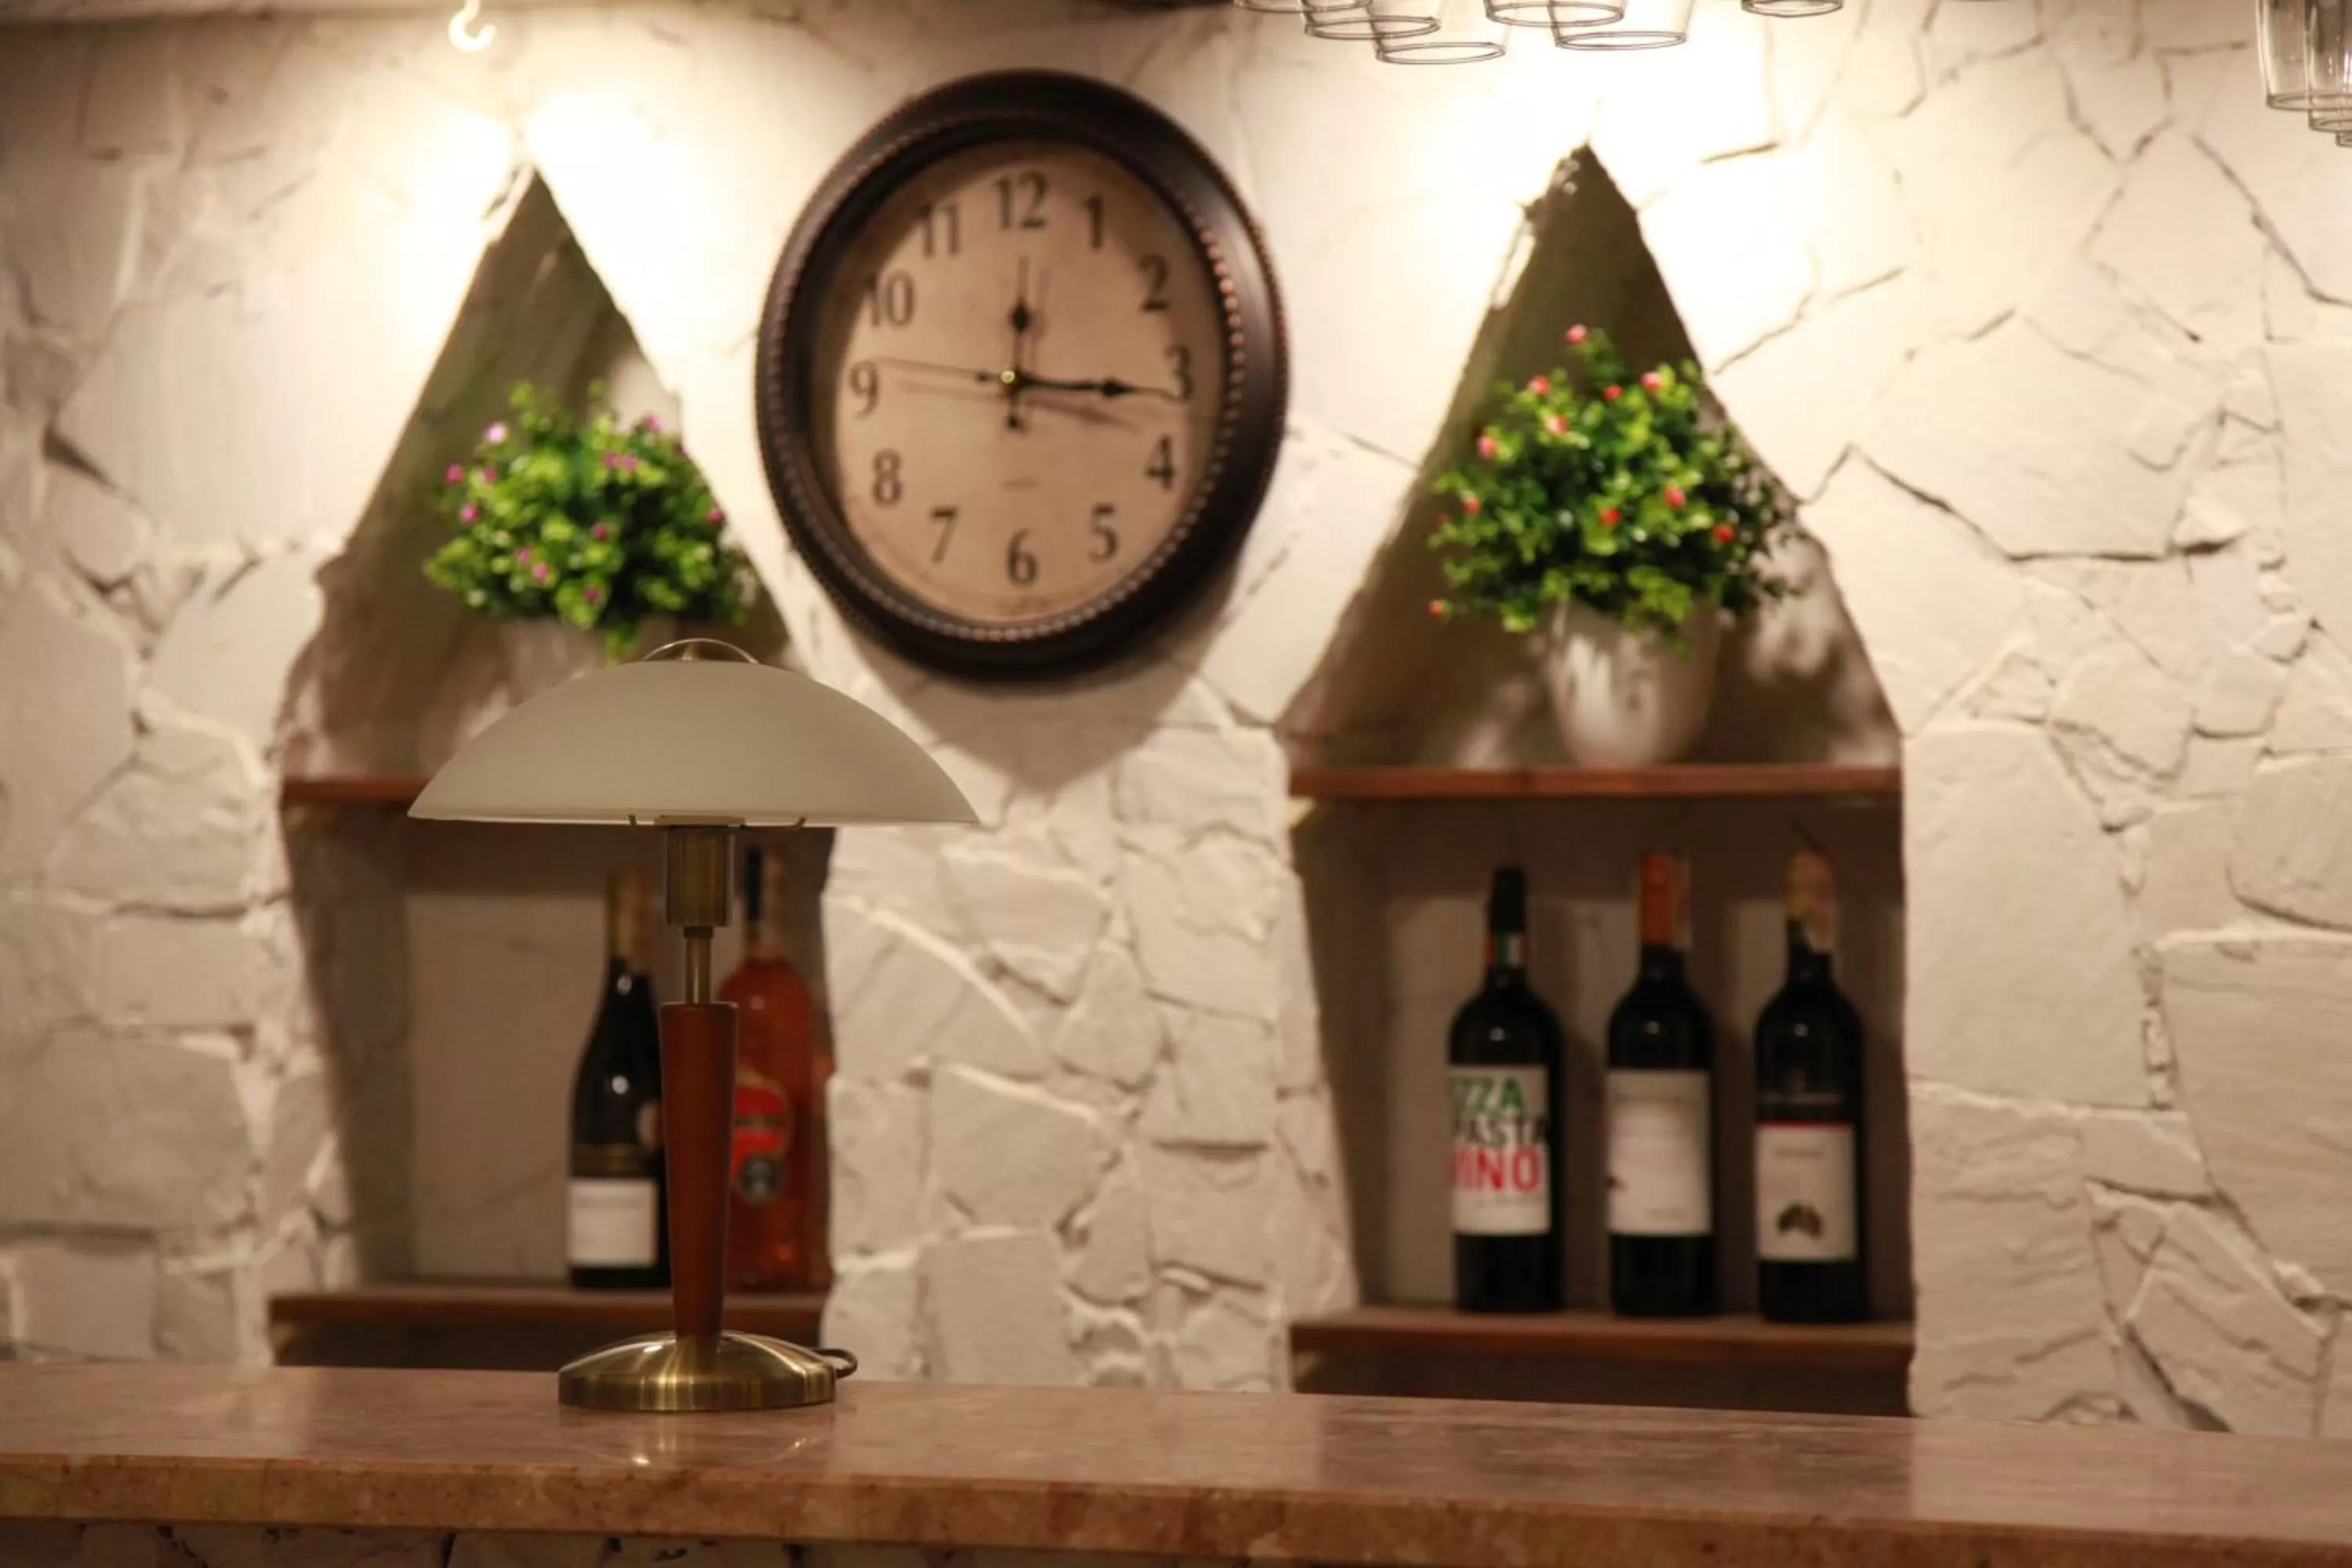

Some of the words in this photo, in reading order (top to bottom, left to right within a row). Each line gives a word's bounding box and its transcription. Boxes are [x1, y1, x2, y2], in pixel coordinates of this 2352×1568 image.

[994, 171, 1047, 229] 12
[1084, 196, 1104, 250] 1
[920, 205, 960, 257] 11
[865, 269, 916, 328] 10
[1139, 254, 1170, 312] 2
[850, 361, 879, 418] 9
[1163, 344, 1192, 401] 3
[872, 450, 902, 506] 8
[1143, 435, 1174, 490] 4
[931, 506, 958, 563] 7
[1007, 529, 1038, 586] 6
[1091, 503, 1119, 561] 5
